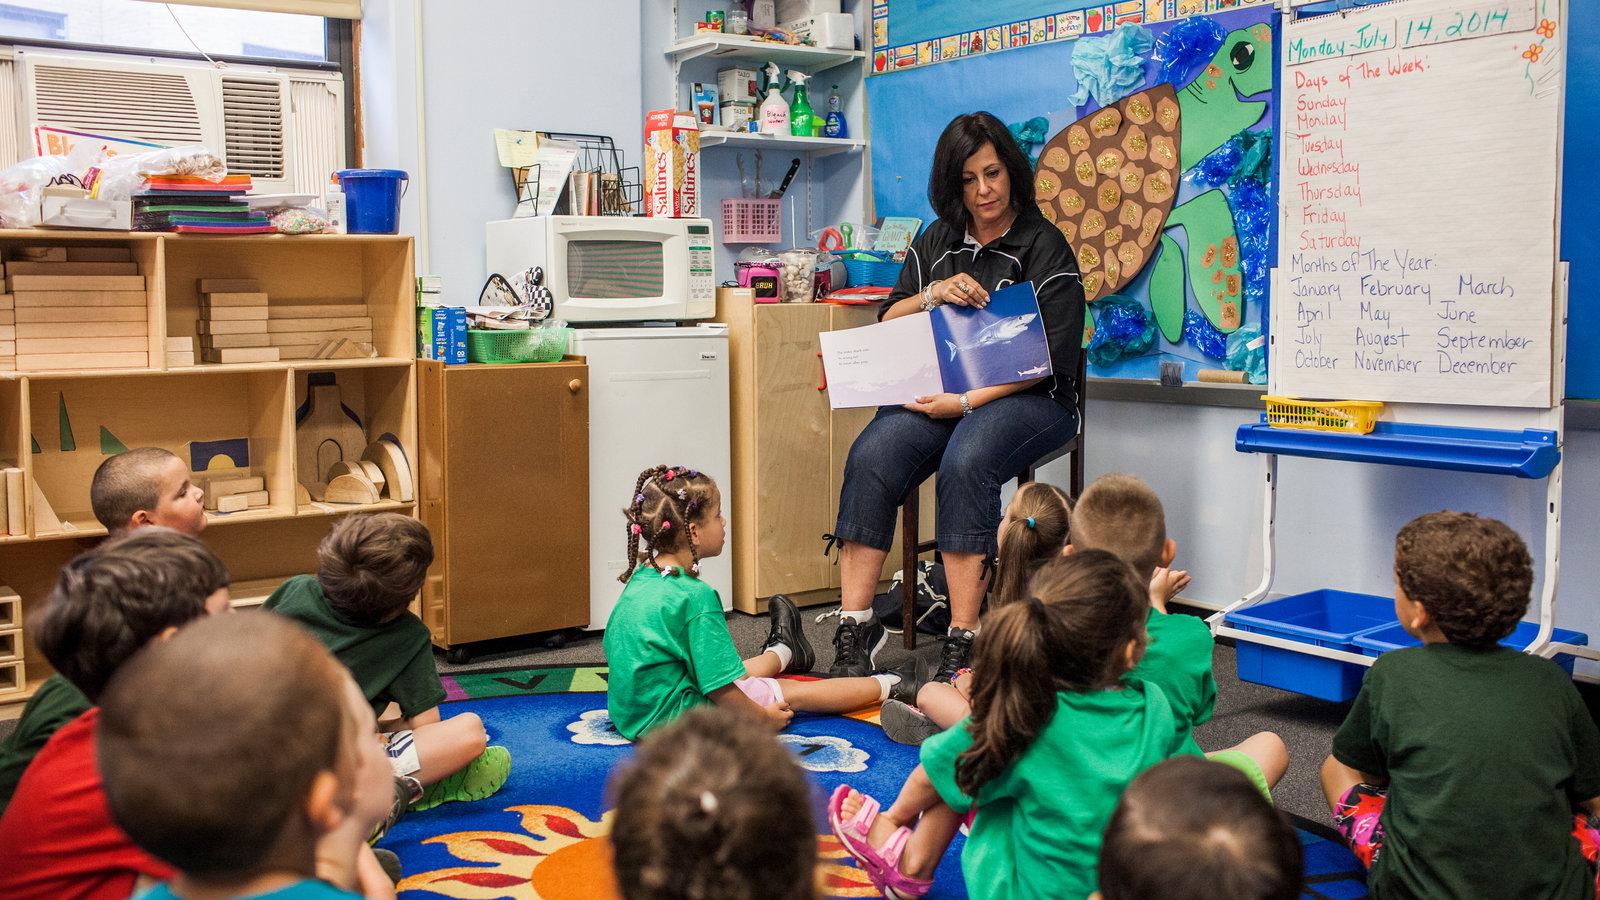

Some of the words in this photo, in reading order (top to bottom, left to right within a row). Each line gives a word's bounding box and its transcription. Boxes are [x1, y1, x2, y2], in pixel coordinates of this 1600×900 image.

[1288, 37, 1345, 63] Monday
[1350, 23, 1388, 49] July
[1446, 8, 1509, 36] 2014
[1295, 71, 1328, 93] Days
[1338, 65, 1352, 89] of
[1355, 62, 1381, 80] The
[1387, 54, 1431, 76] Week:
[1297, 93, 1347, 112] Sunday
[1297, 112, 1347, 131] Monday
[1297, 133, 1345, 159] Tuesday
[655, 152, 668, 215] Saltines
[683, 152, 696, 215] Saltines
[1298, 157, 1360, 185] Wednesday
[1298, 181, 1362, 207] Thursday
[1303, 205, 1347, 233] Friday
[1300, 230, 1361, 264] Saturday
[1292, 253, 1337, 273] Months
[1341, 252, 1360, 273] of
[1361, 249, 1390, 272] The
[1394, 249, 1437, 279] Year:
[1291, 275, 1341, 300] January
[1360, 274, 1432, 305] February
[1458, 273, 1515, 298] March
[1297, 301, 1331, 325] April
[1360, 301, 1391, 328] May
[1437, 301, 1477, 324] June
[1295, 325, 1322, 351] July
[1437, 326, 1535, 352] September
[1295, 350, 1338, 370] October
[1354, 350, 1424, 374] November
[1438, 350, 1518, 375] December
